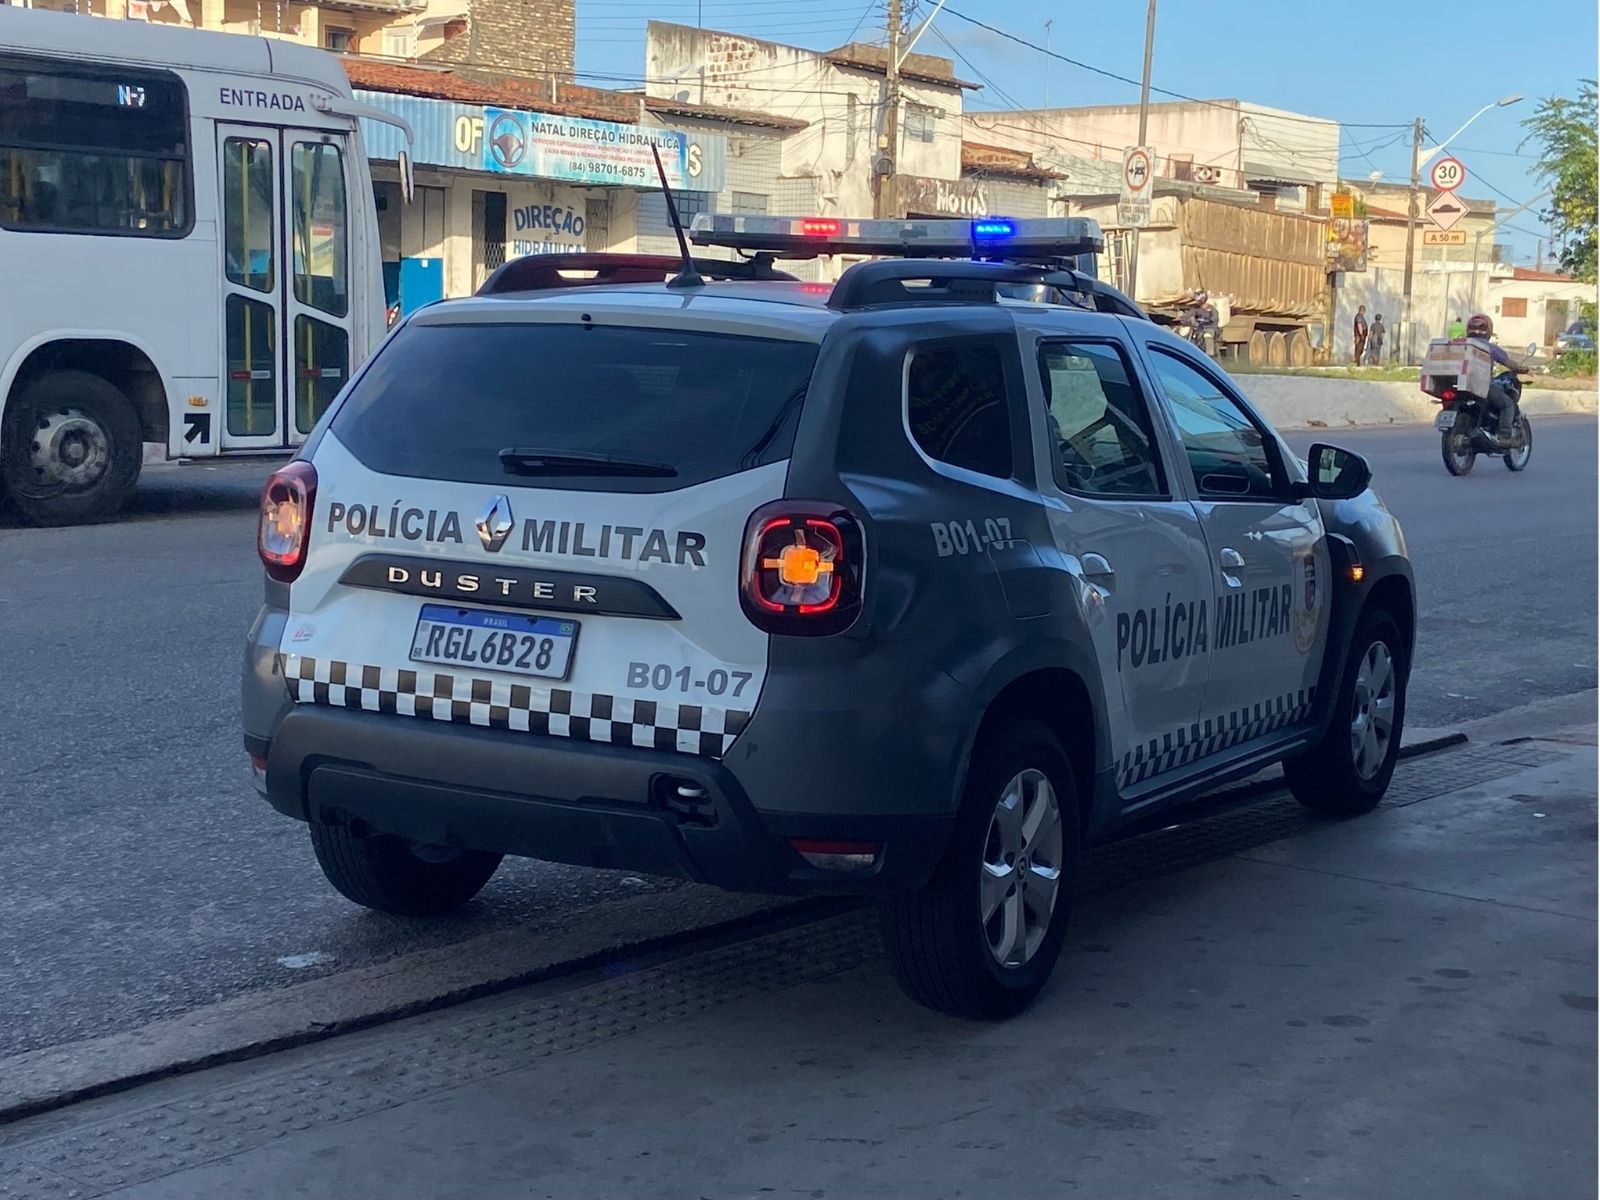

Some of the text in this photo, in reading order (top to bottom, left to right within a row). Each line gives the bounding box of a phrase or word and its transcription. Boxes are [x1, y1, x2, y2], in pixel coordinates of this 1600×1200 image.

[220, 87, 306, 112] ENTRADA
[532, 122, 566, 137] NATAL
[569, 161, 586, 174] (84)
[588, 162, 645, 178] 98701-6875
[1438, 165, 1457, 179] 30
[514, 205, 584, 236] DIREÇÃO
[1430, 234, 1437, 242] A
[1440, 234, 1449, 242] 50
[327, 499, 707, 567] POLÍCIA MILITAR
[930, 516, 1013, 558] B01-07
[387, 566, 599, 604] DUSTER
[483, 616, 508, 628] BRASIL
[1117, 584, 1293, 671] POLÍCIA MILITAR
[425, 625, 554, 671] RGL6B28
[627, 661, 753, 698] B01-07
